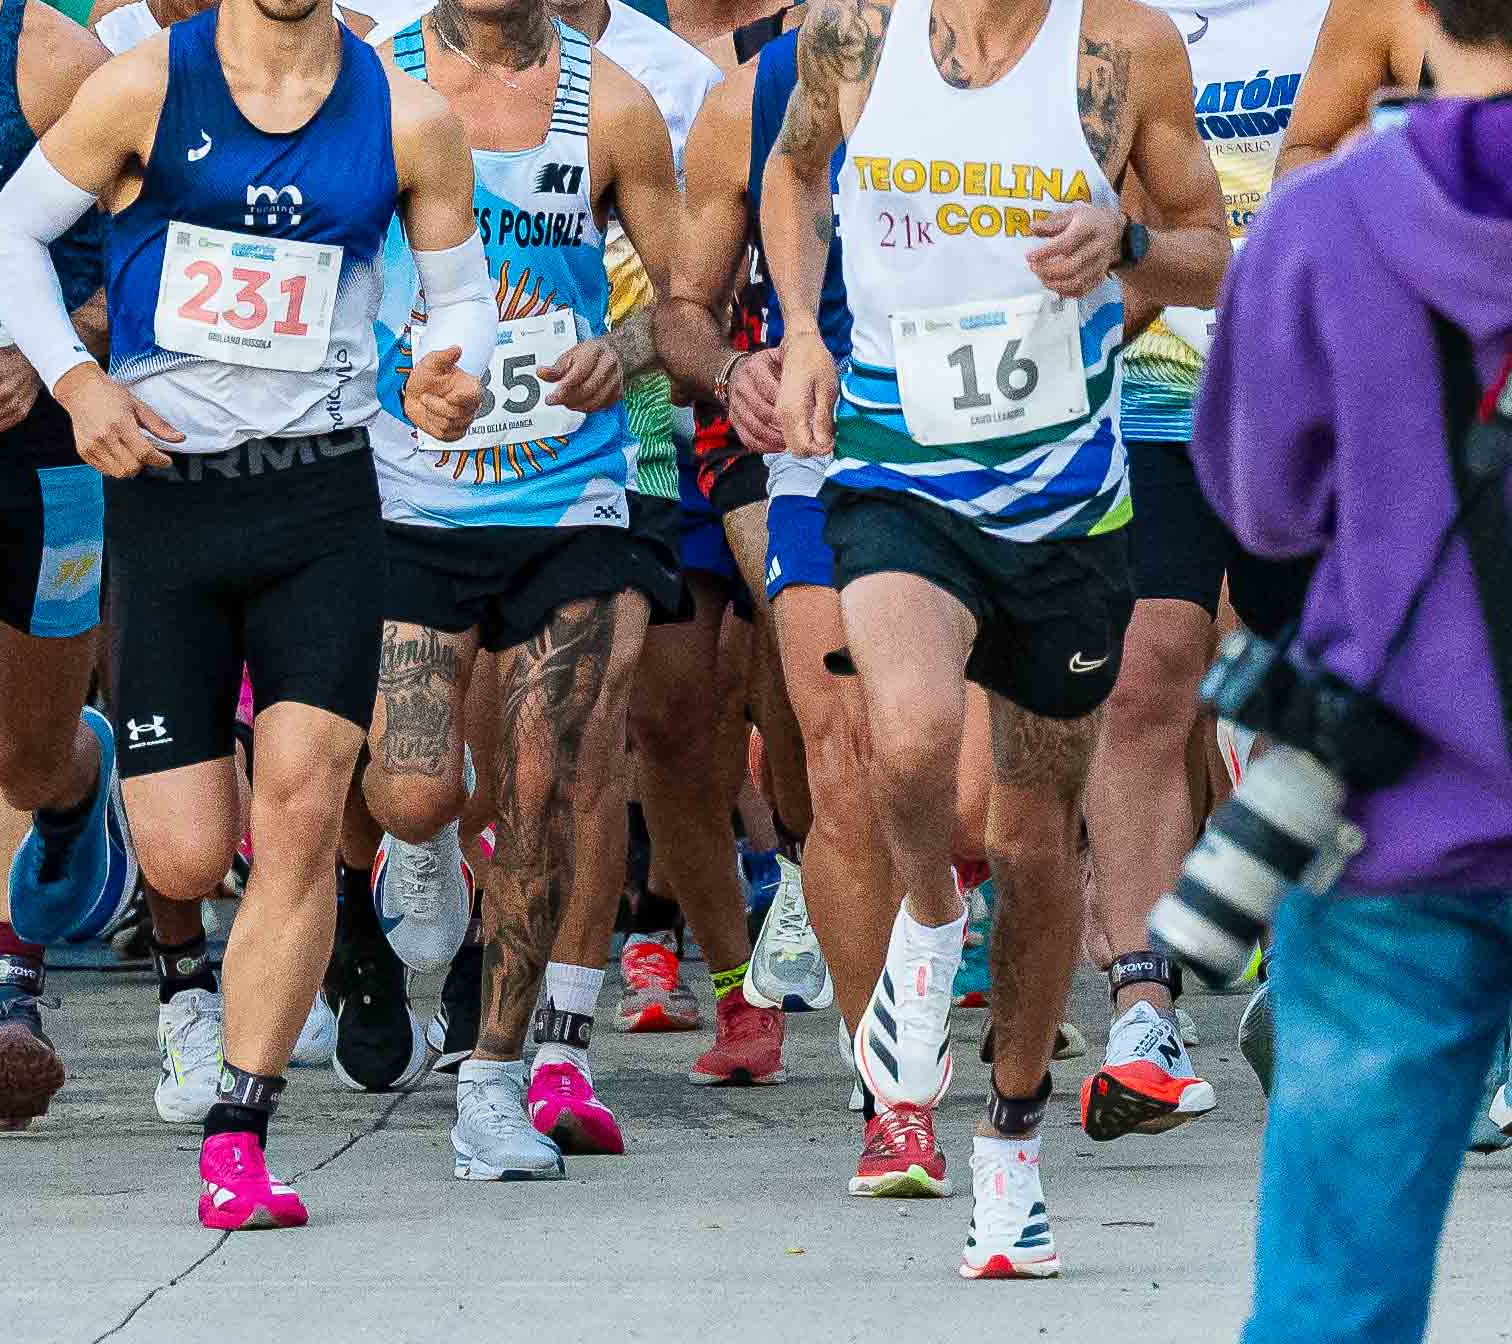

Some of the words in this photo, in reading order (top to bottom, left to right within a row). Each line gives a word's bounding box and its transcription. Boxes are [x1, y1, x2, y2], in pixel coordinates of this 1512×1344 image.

[854, 156, 1093, 204] TEODELINA
[498, 208, 587, 249] POSIBLE
[178, 260, 308, 337] 231
[947, 339, 1039, 410] 16
